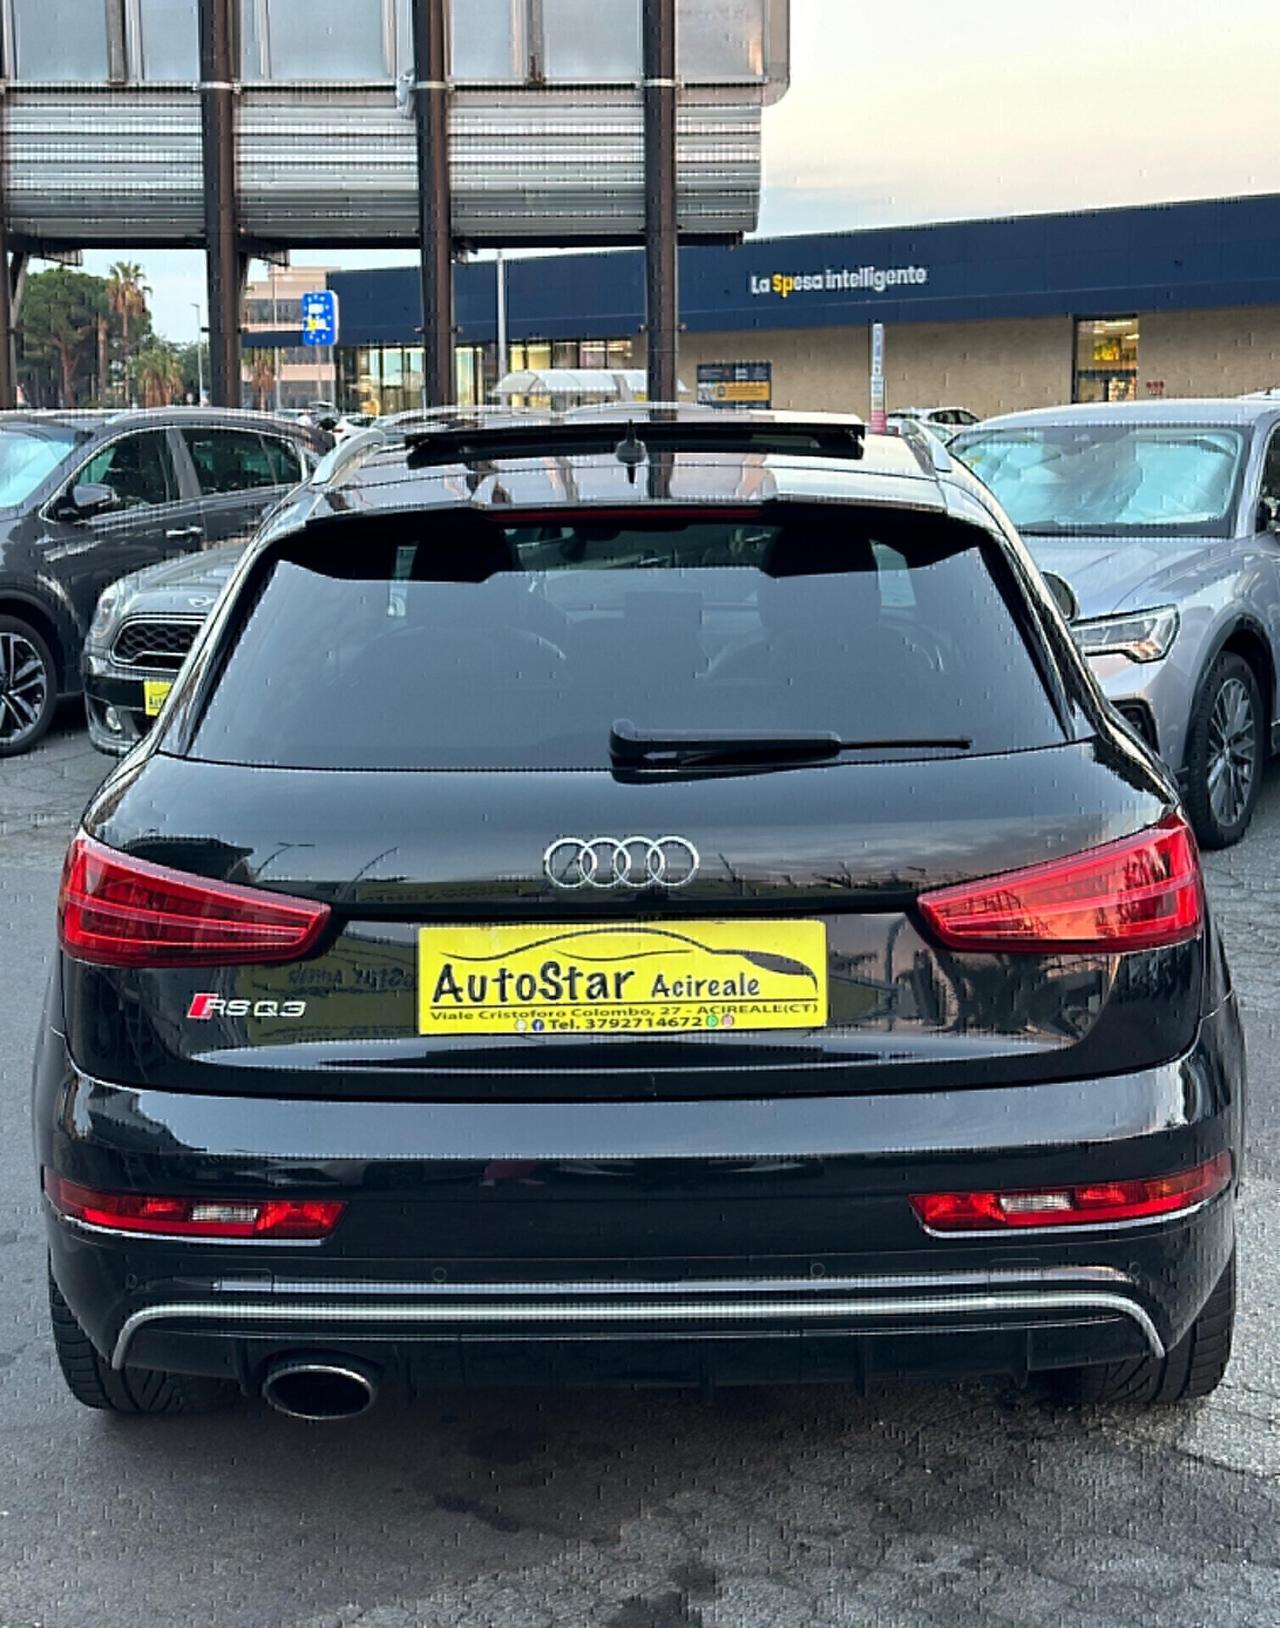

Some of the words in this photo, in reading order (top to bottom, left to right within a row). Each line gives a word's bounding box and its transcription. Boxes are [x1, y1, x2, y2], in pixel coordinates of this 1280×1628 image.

[751, 276, 770, 294] La
[772, 274, 823, 298] Spesa
[825, 266, 928, 292] intelligente
[432, 960, 636, 1003] AutoStar
[651, 971, 760, 998] Acireale
[431, 1010, 474, 1020] Viale
[478, 1008, 566, 1019] Cristoforo
[571, 1006, 656, 1017] Colombo,
[660, 1006, 681, 1016] 27
[696, 1003, 818, 1015] ACIREALE(CT)
[548, 1018, 580, 1030] Tel.
[585, 1016, 702, 1029] 3792714672
